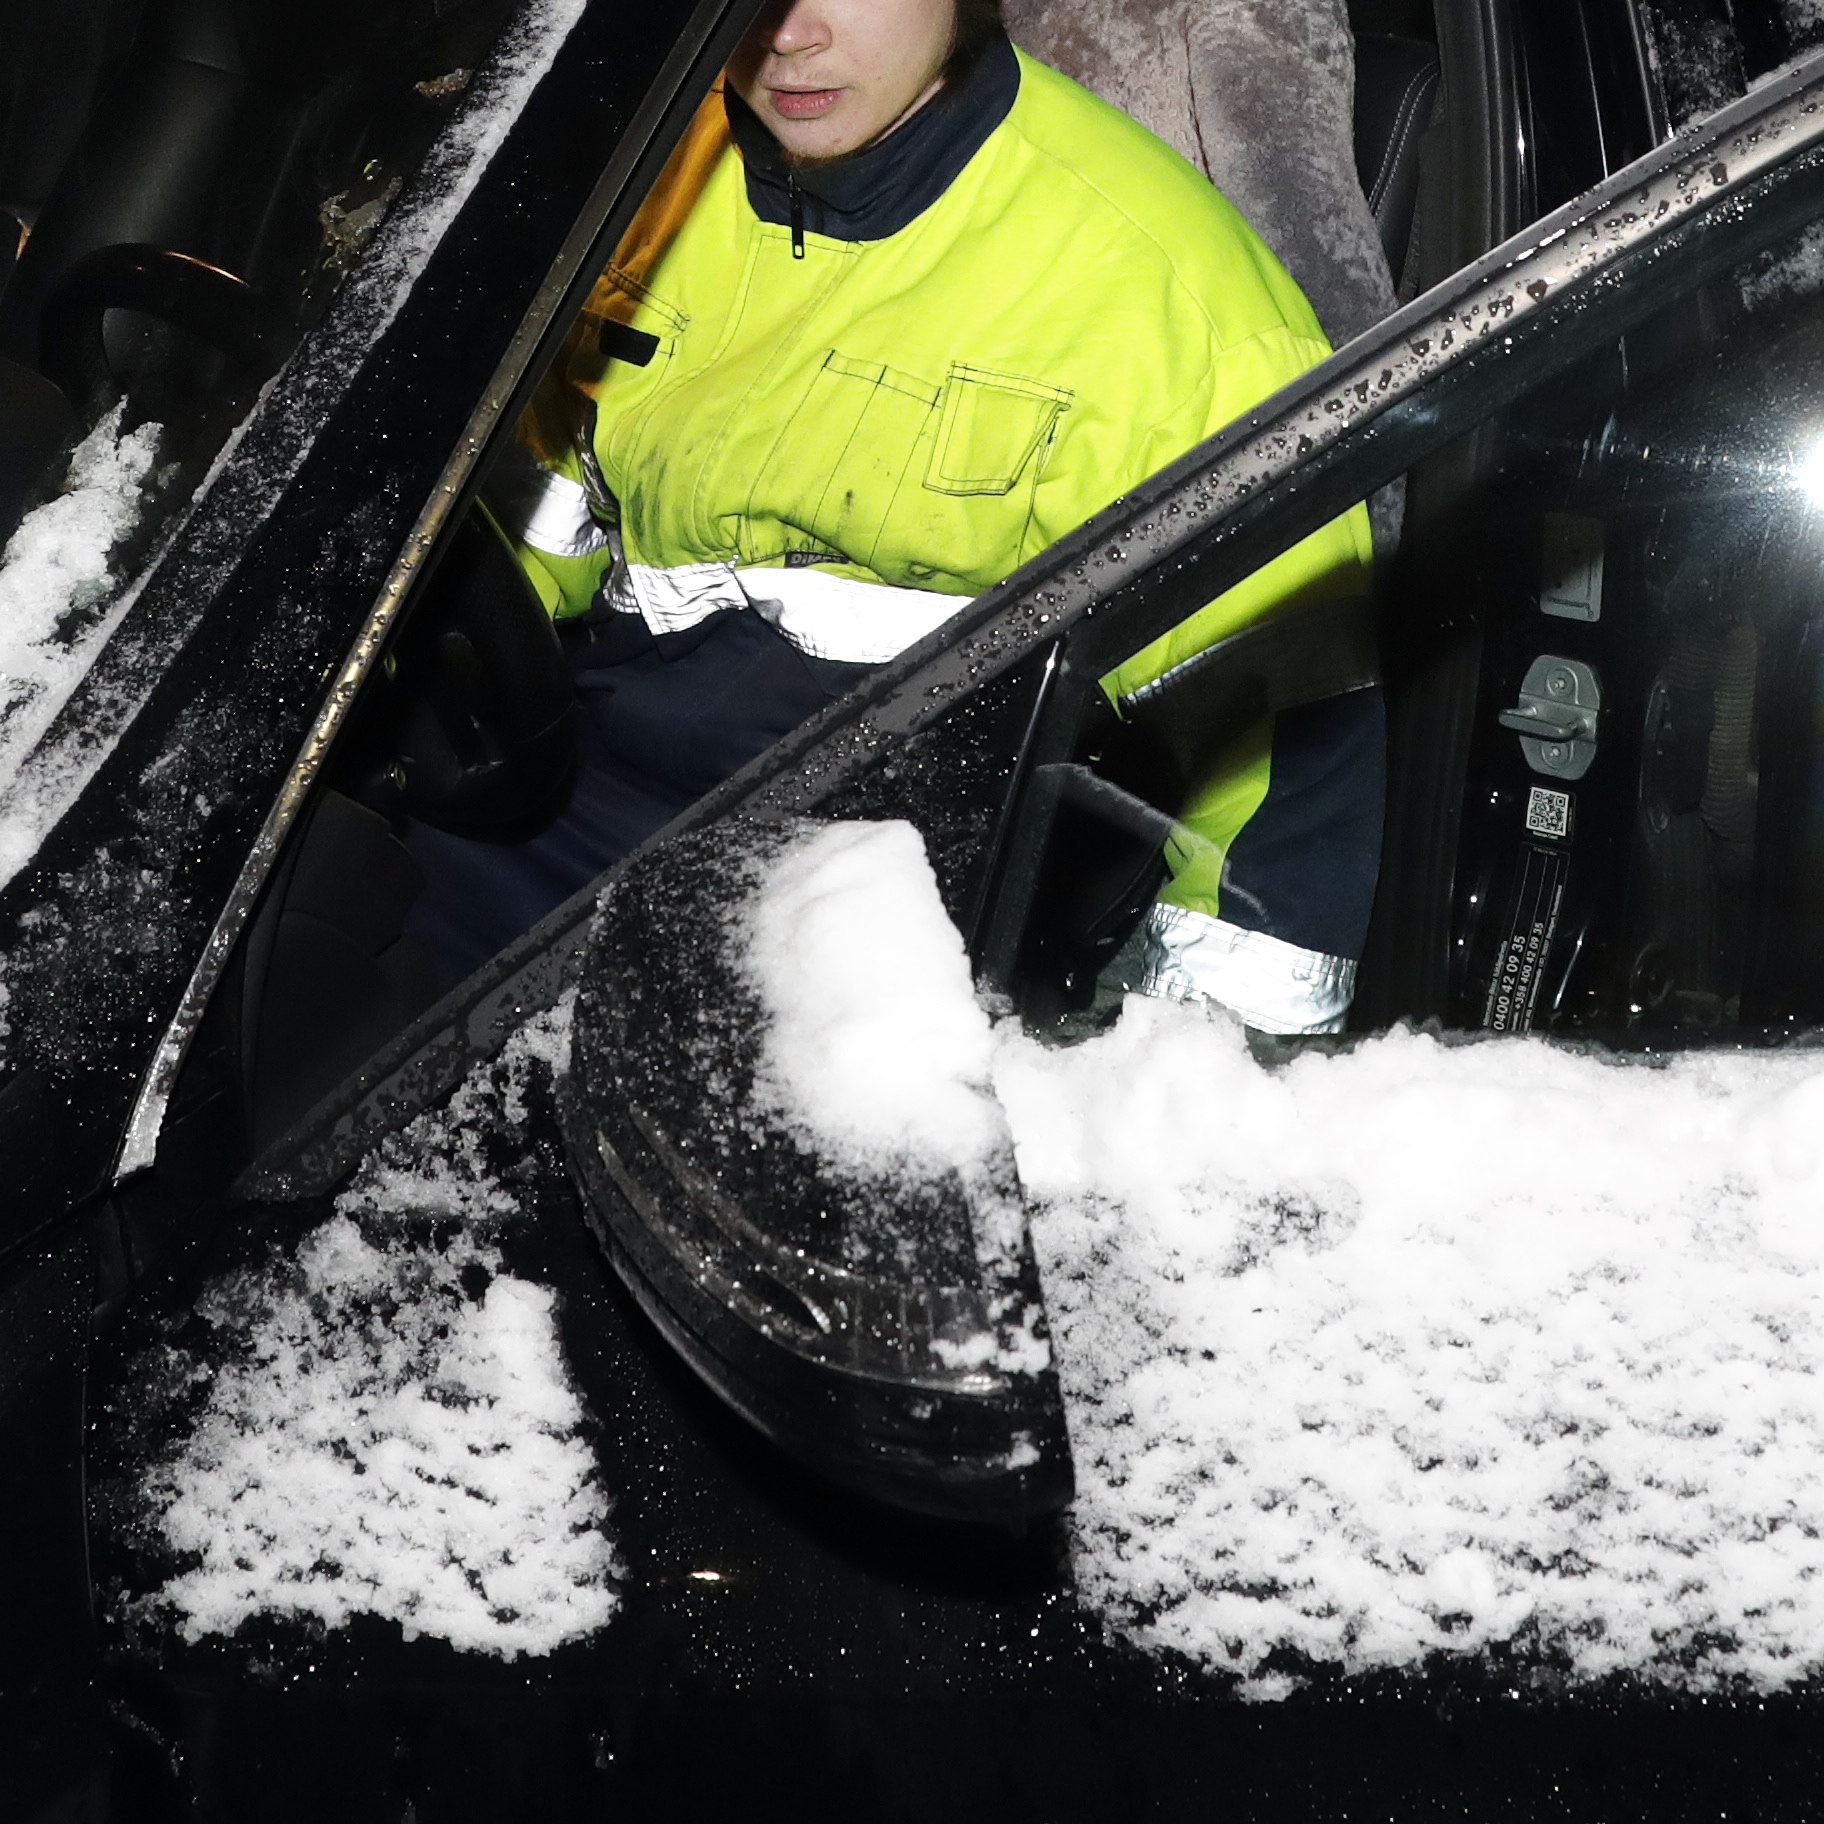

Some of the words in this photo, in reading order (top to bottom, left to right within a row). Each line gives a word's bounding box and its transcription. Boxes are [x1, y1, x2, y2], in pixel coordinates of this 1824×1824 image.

[1533, 922, 1544, 936] 35
[1512, 935, 1527, 953] 35
[1529, 936, 1539, 950] 09
[1506, 954, 1520, 973] 09
[1526, 950, 1536, 964] 42
[1521, 964, 1532, 984] 400
[1502, 975, 1515, 994] 42
[1515, 985, 1527, 1010] +358
[1493, 996, 1511, 1031] 0400
